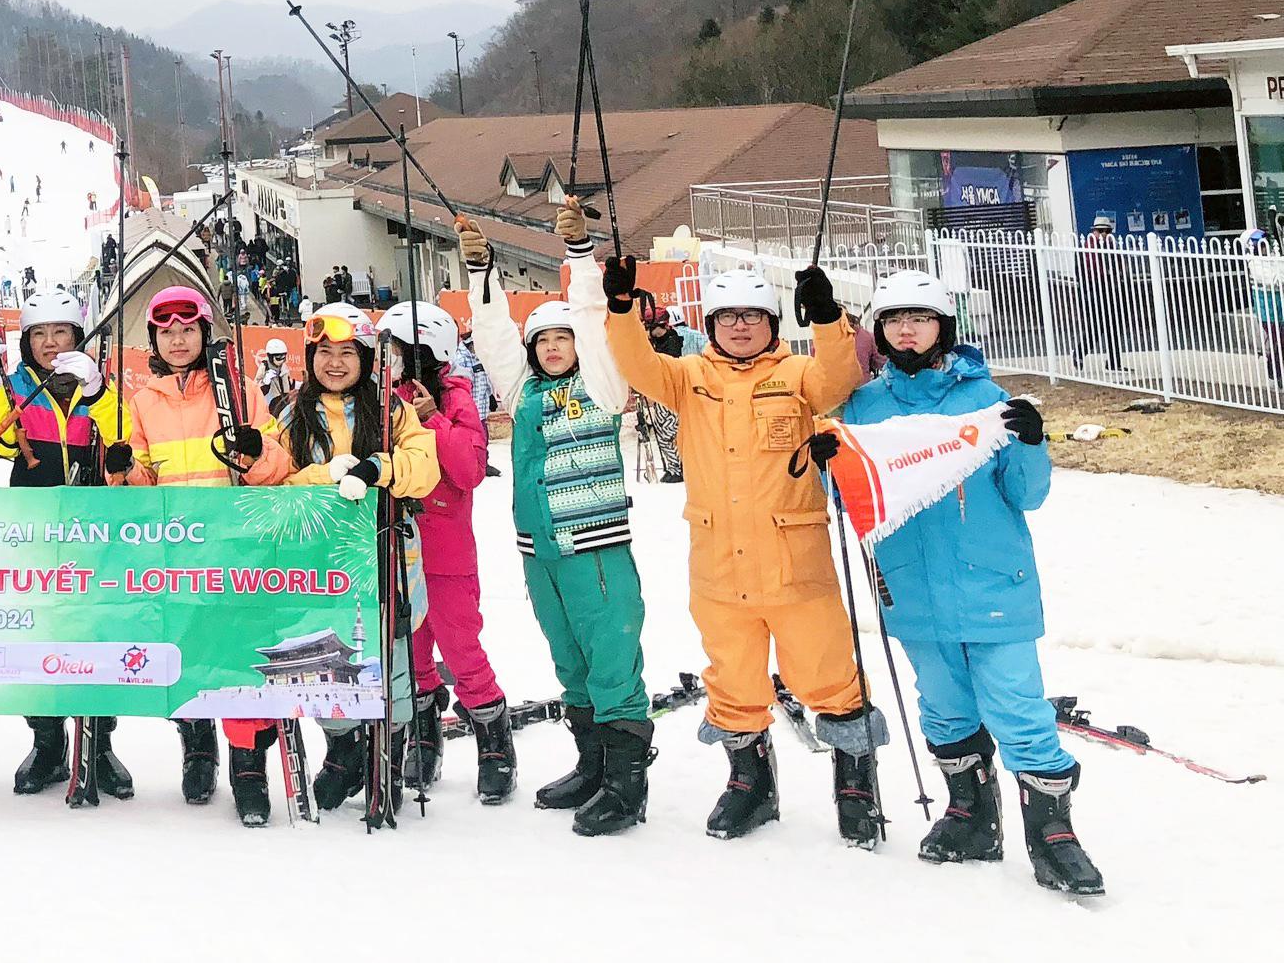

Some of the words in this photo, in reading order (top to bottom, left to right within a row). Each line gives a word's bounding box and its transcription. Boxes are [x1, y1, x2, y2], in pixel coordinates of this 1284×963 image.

[976, 187, 1000, 205] YMCA
[886, 447, 934, 472] Follow
[937, 439, 962, 455] me
[44, 518, 110, 543] HÀN
[119, 515, 205, 545] QUỐC
[125, 568, 225, 594] LOTTE
[229, 568, 351, 595] WORLD
